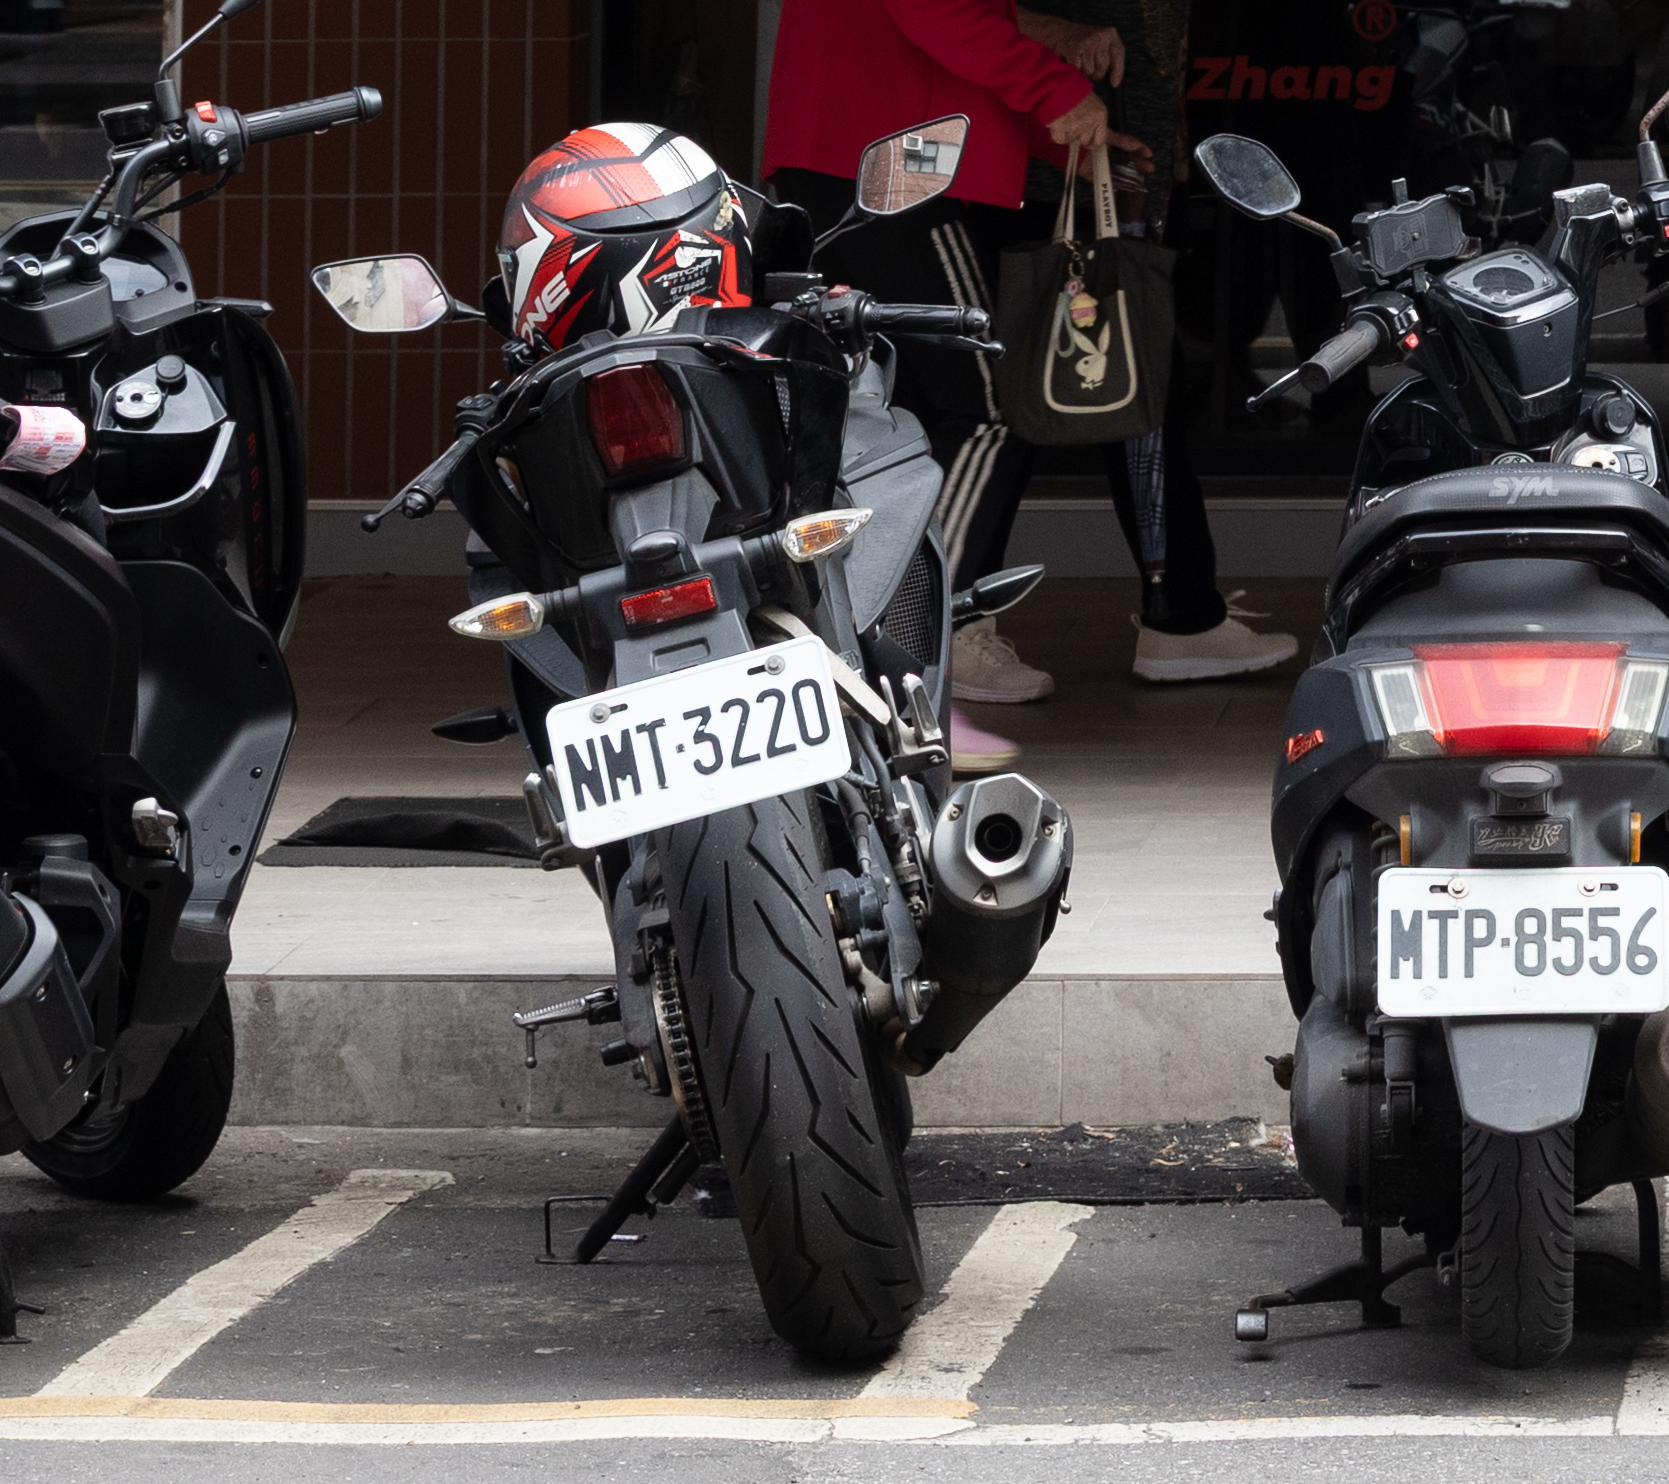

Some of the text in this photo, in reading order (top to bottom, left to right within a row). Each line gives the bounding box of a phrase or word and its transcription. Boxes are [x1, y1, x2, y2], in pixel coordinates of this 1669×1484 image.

[1189, 56, 1396, 110] Zhang
[1102, 183, 1113, 228] PLAYBOY
[673, 267, 709, 284] FRANCE
[1488, 477, 1559, 504] SYM
